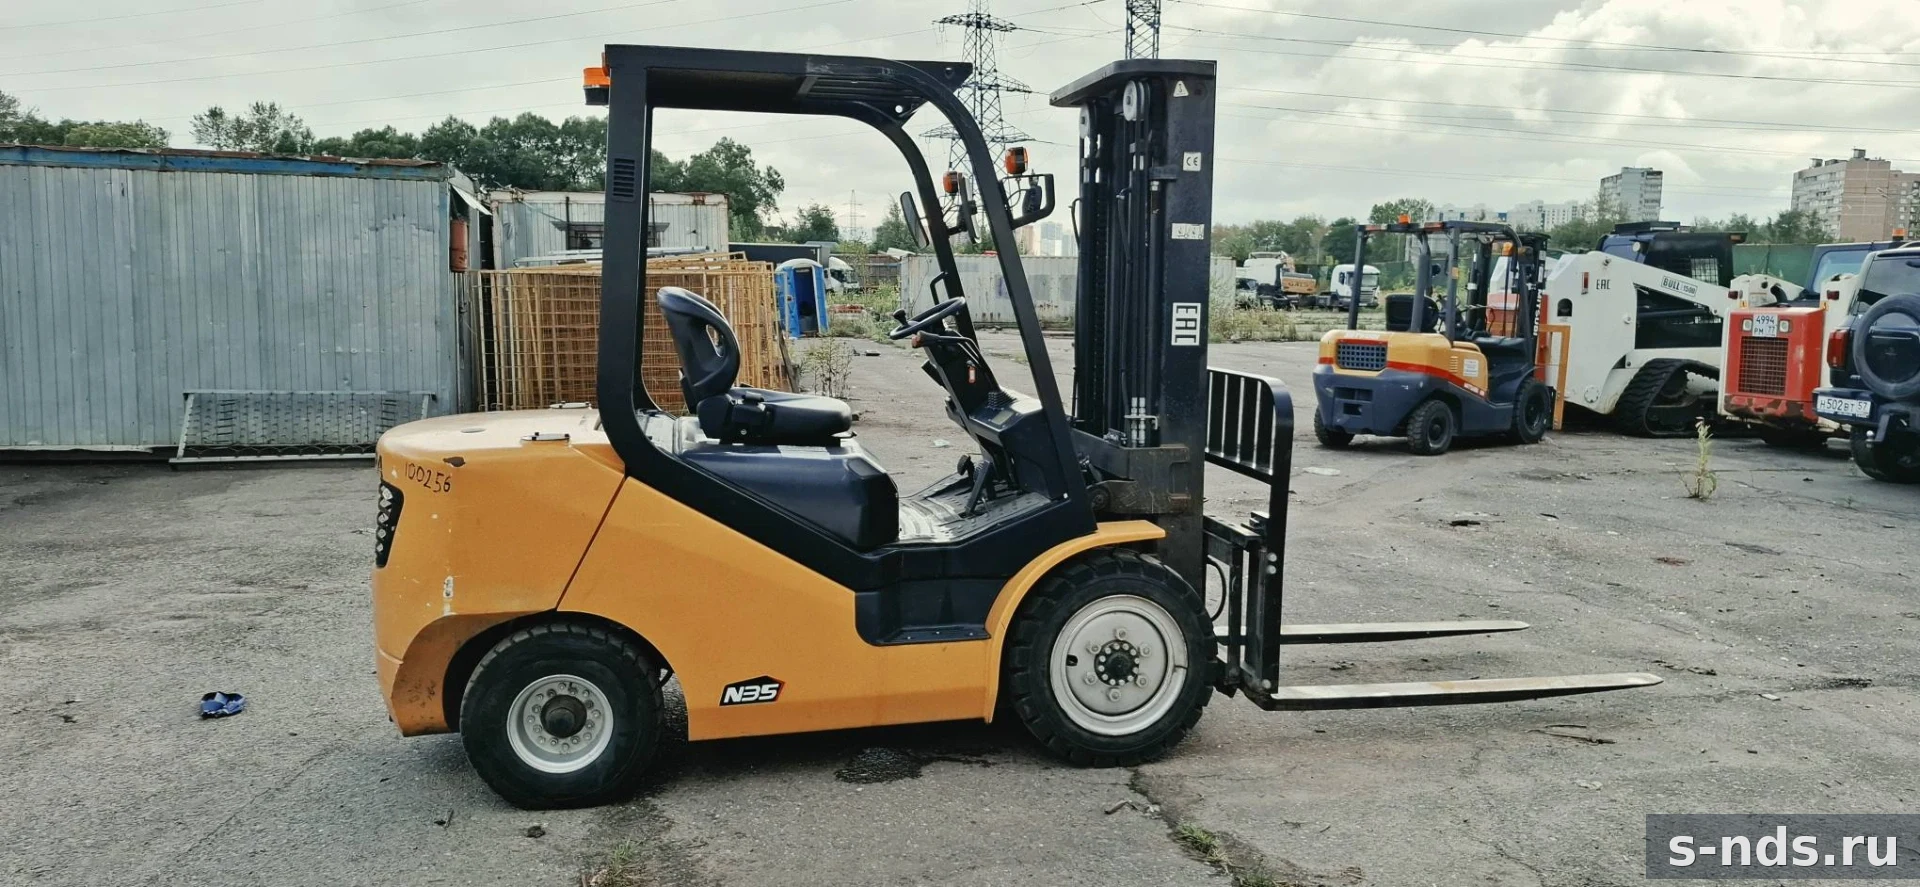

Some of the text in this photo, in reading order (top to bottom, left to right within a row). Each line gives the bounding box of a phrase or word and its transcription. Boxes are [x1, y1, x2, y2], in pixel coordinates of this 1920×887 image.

[1186, 157, 1198, 166] CE
[1663, 278, 1680, 290] BULL
[1756, 315, 1775, 325] 4994
[1857, 401, 1868, 411] 57
[405, 461, 452, 493] 100256
[723, 683, 780, 704] N35
